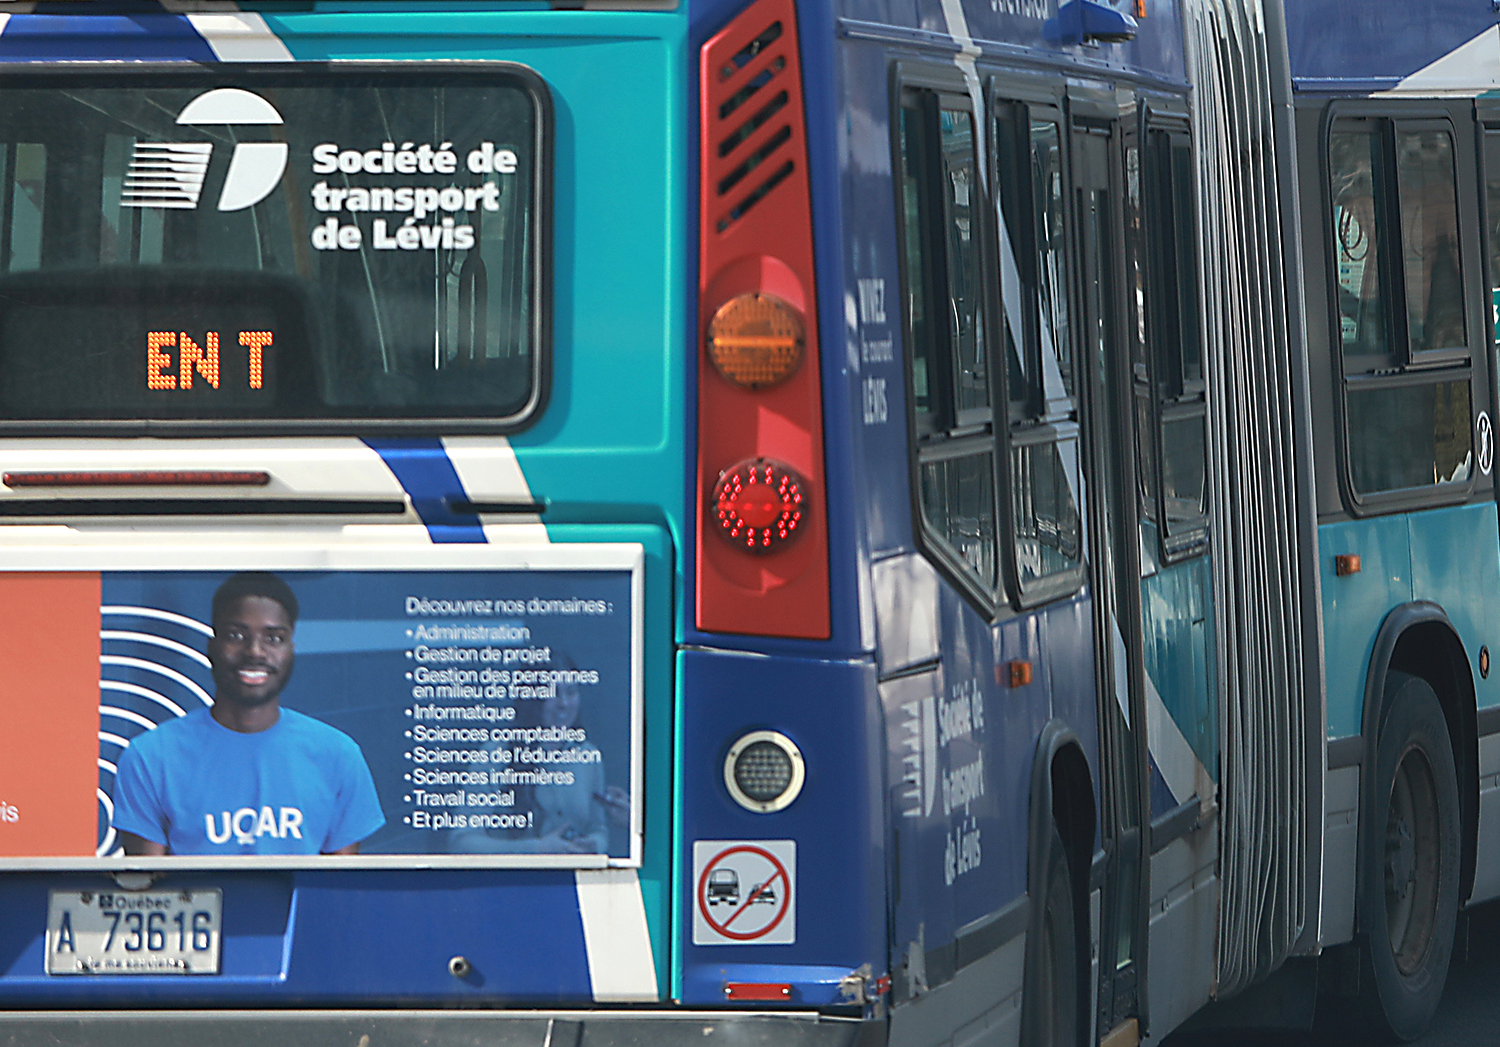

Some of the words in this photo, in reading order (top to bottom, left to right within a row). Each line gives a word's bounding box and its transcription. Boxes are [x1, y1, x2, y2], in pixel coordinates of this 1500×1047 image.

[311, 141, 457, 175] Société
[467, 142, 518, 175] de
[311, 181, 500, 220] transport
[311, 218, 363, 251] de
[372, 216, 476, 251] Lévis
[147, 330, 220, 390] EN
[238, 330, 273, 390] T
[405, 596, 493, 615] Découvrez
[495, 599, 525, 615] nos
[415, 623, 530, 641] Administration
[414, 645, 478, 663] Gestion
[479, 645, 502, 663] de
[503, 645, 551, 665] projet
[413, 666, 478, 684] Gestion
[479, 667, 511, 684] des
[512, 669, 599, 685] personnes
[412, 685, 434, 699] en
[437, 683, 483, 699] milieu
[484, 683, 507, 699] de
[508, 683, 557, 699] travail
[413, 703, 516, 722] Informatique
[938, 680, 972, 747] Société
[972, 677, 985, 732] de
[412, 724, 489, 742] Sciences
[490, 725, 587, 744] comptables
[412, 746, 489, 764] Sciences
[491, 746, 513, 764] de
[514, 746, 601, 764] l'éducation
[412, 767, 489, 785] Sciences
[490, 767, 575, 785] infirmières
[941, 749, 985, 816] transport
[413, 789, 465, 806] Travail
[467, 790, 515, 806] social
[0, 800, 20, 823] is
[412, 811, 432, 828] Et
[433, 811, 467, 830] plus
[204, 806, 304, 845] UQAR
[944, 832, 957, 886] de
[957, 816, 982, 875] Lévis
[115, 892, 171, 910] Québec
[56, 911, 75, 953] A
[102, 911, 211, 953] 73616
